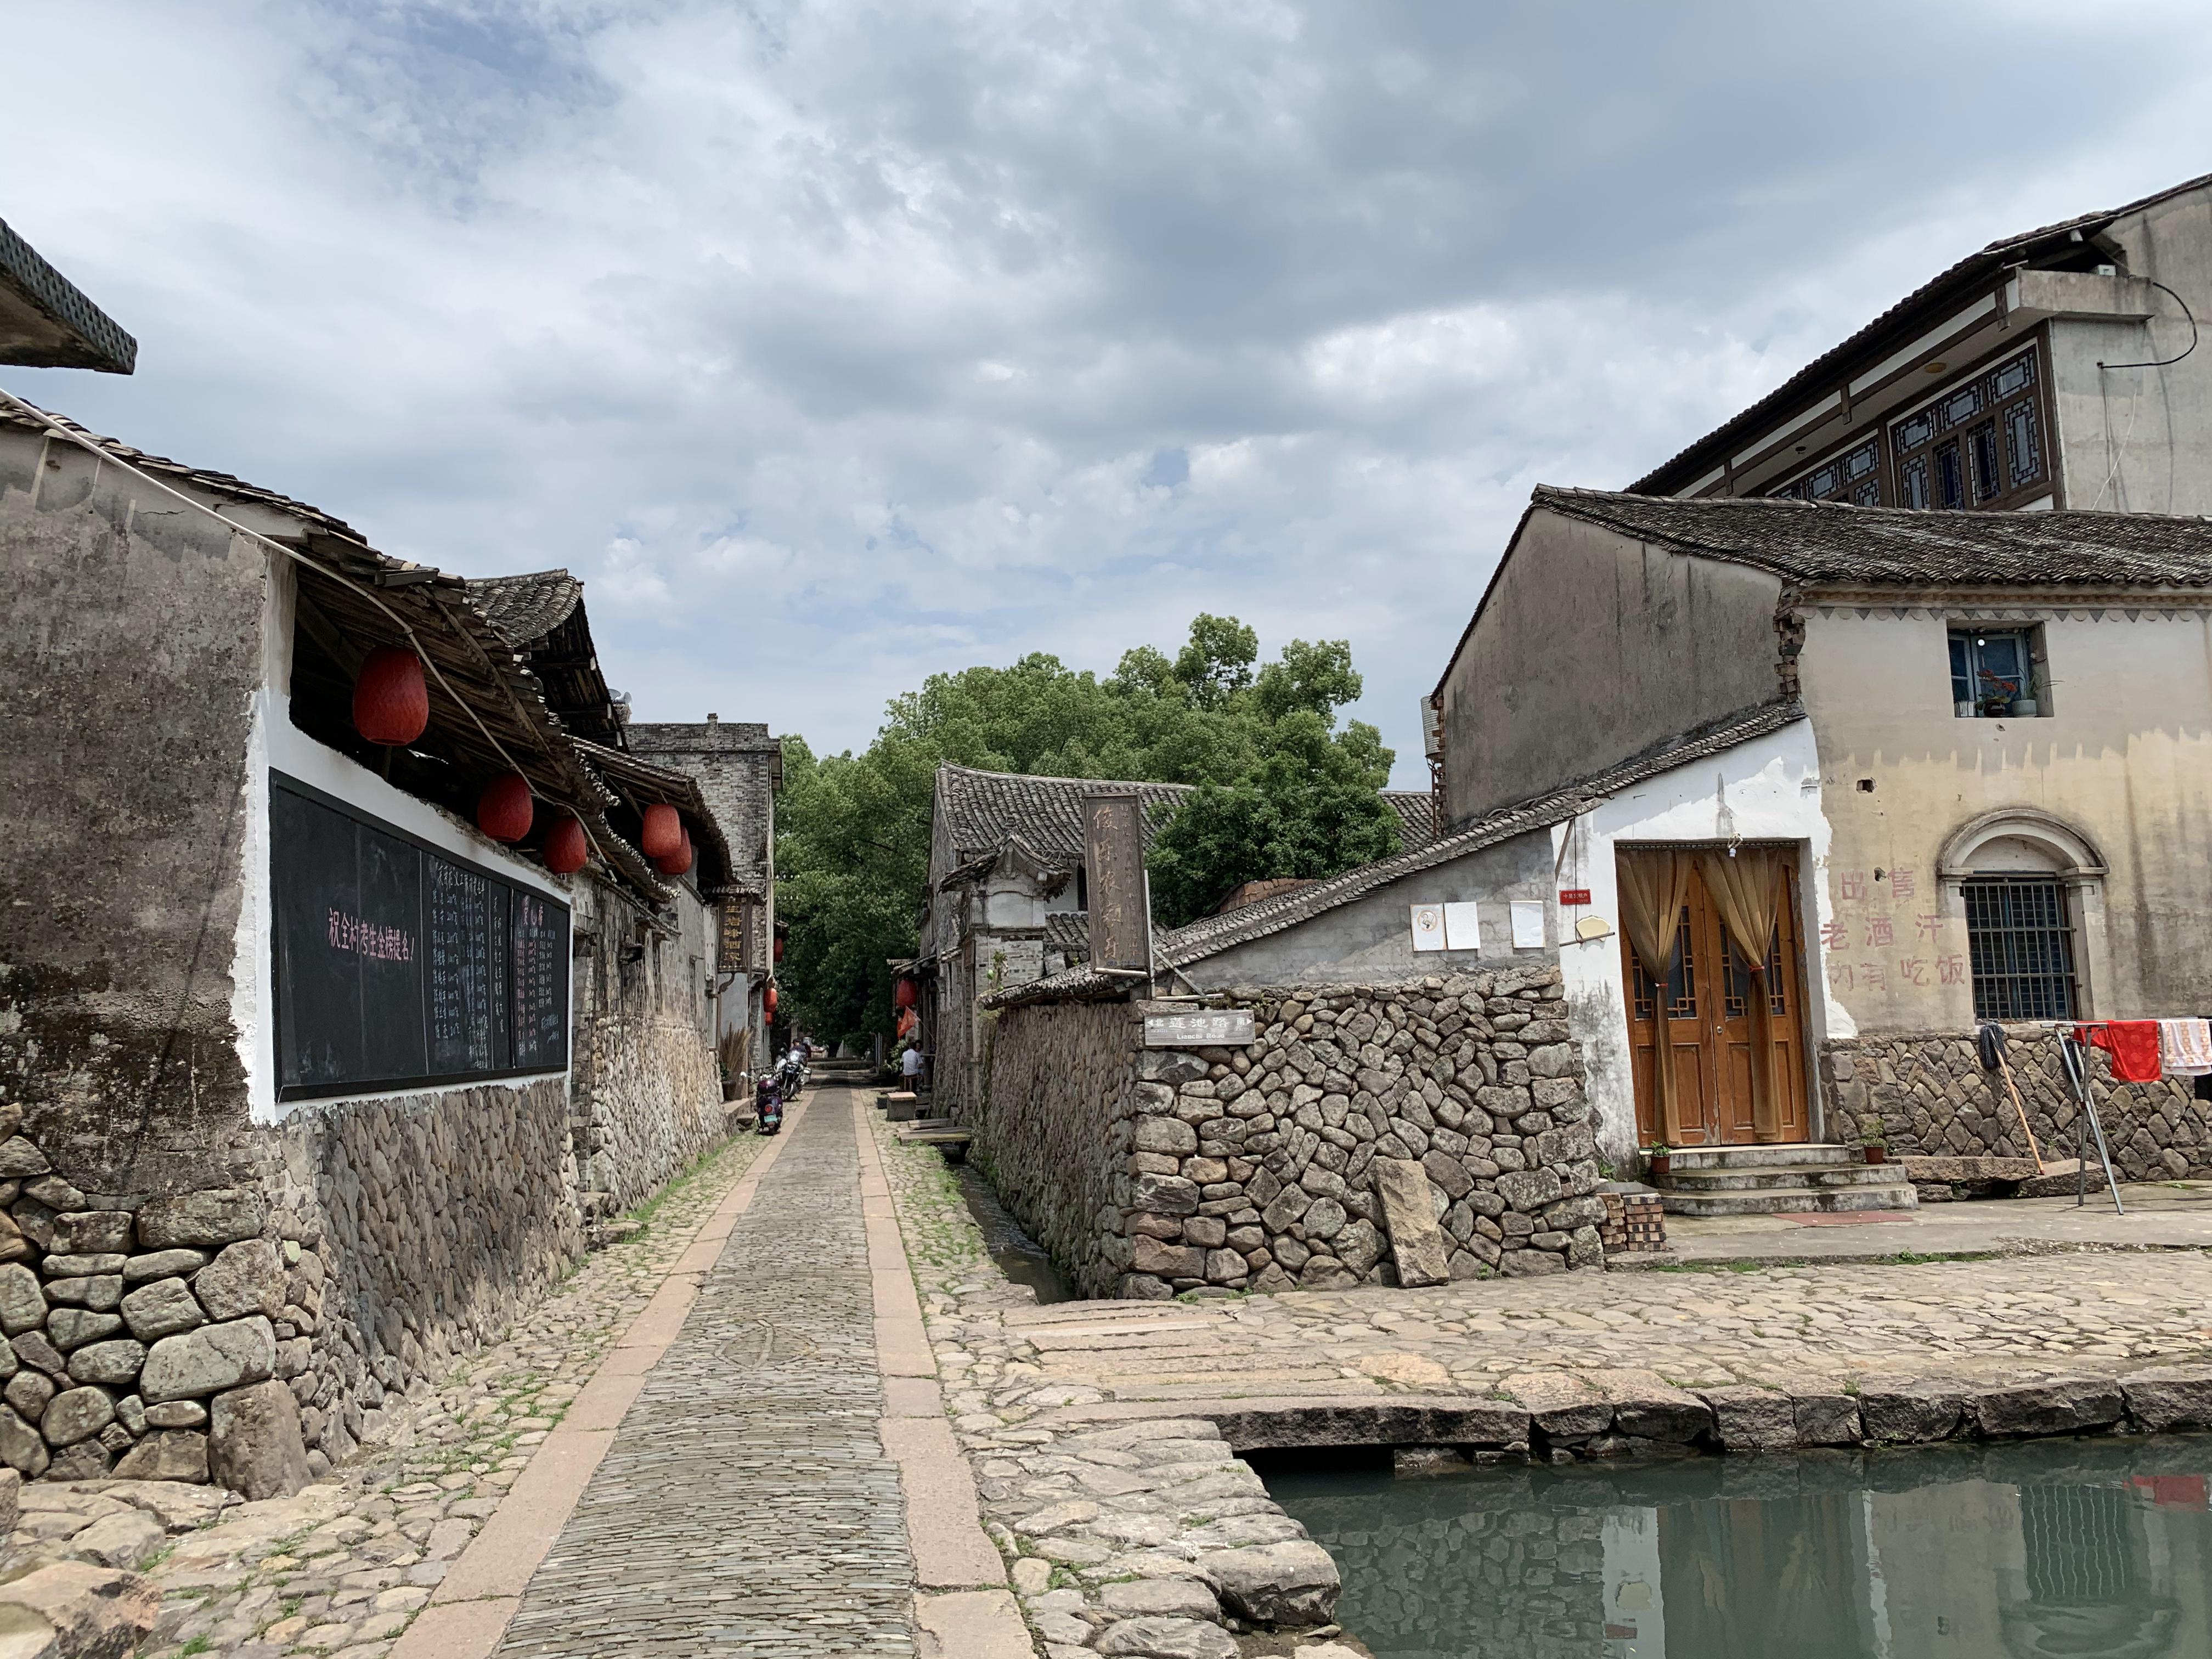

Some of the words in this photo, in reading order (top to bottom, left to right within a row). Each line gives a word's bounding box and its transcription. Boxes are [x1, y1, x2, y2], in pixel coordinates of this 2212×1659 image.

[1820, 913, 1944, 951] 老酒汗
[1155, 1018, 1164, 1026] 北
[1237, 1017, 1245, 1025] 南
